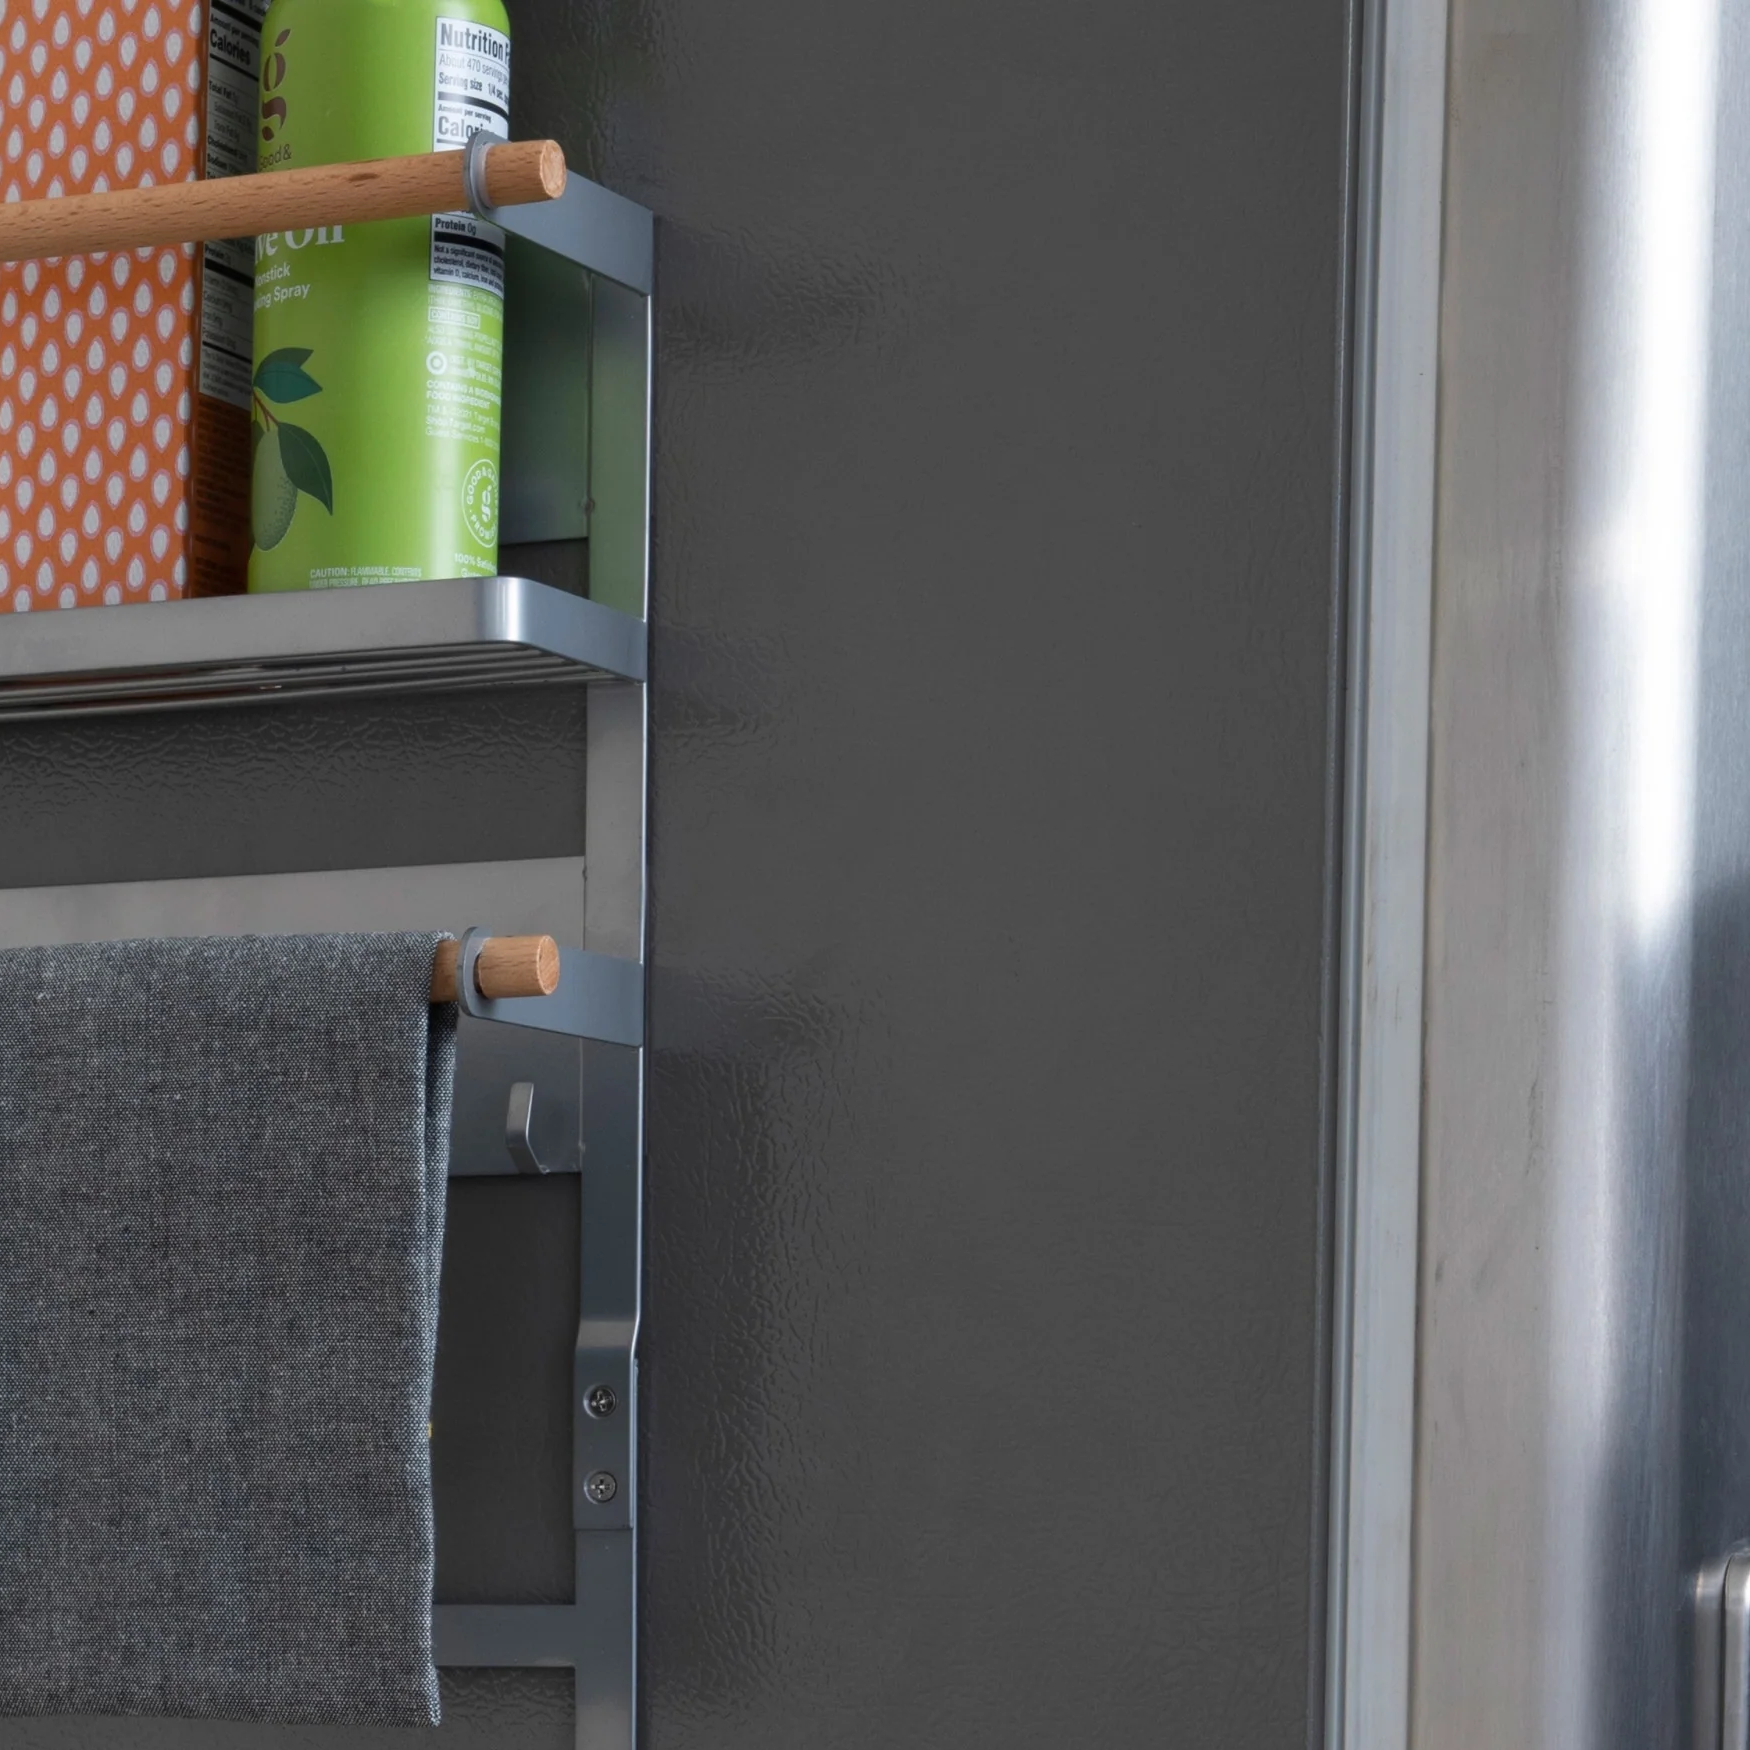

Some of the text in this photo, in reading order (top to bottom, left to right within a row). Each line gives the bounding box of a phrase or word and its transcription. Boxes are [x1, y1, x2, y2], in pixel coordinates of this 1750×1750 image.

[209, 28, 250, 66] Calories
[440, 23, 504, 61] Nutrition
[439, 53, 465, 69] About
[467, 57, 481, 73] 470
[439, 71, 468, 91] Serving
[470, 79, 482, 92] size
[438, 104, 462, 114] Amount
[464, 109, 473, 117] per
[283, 143, 291, 160] &
[434, 217, 477, 236] Protein 0g
[273, 284, 310, 303] Spray
[426, 390, 451, 401] FOOD
[454, 552, 476, 566] 100%
[310, 567, 349, 579] CAUTION:
